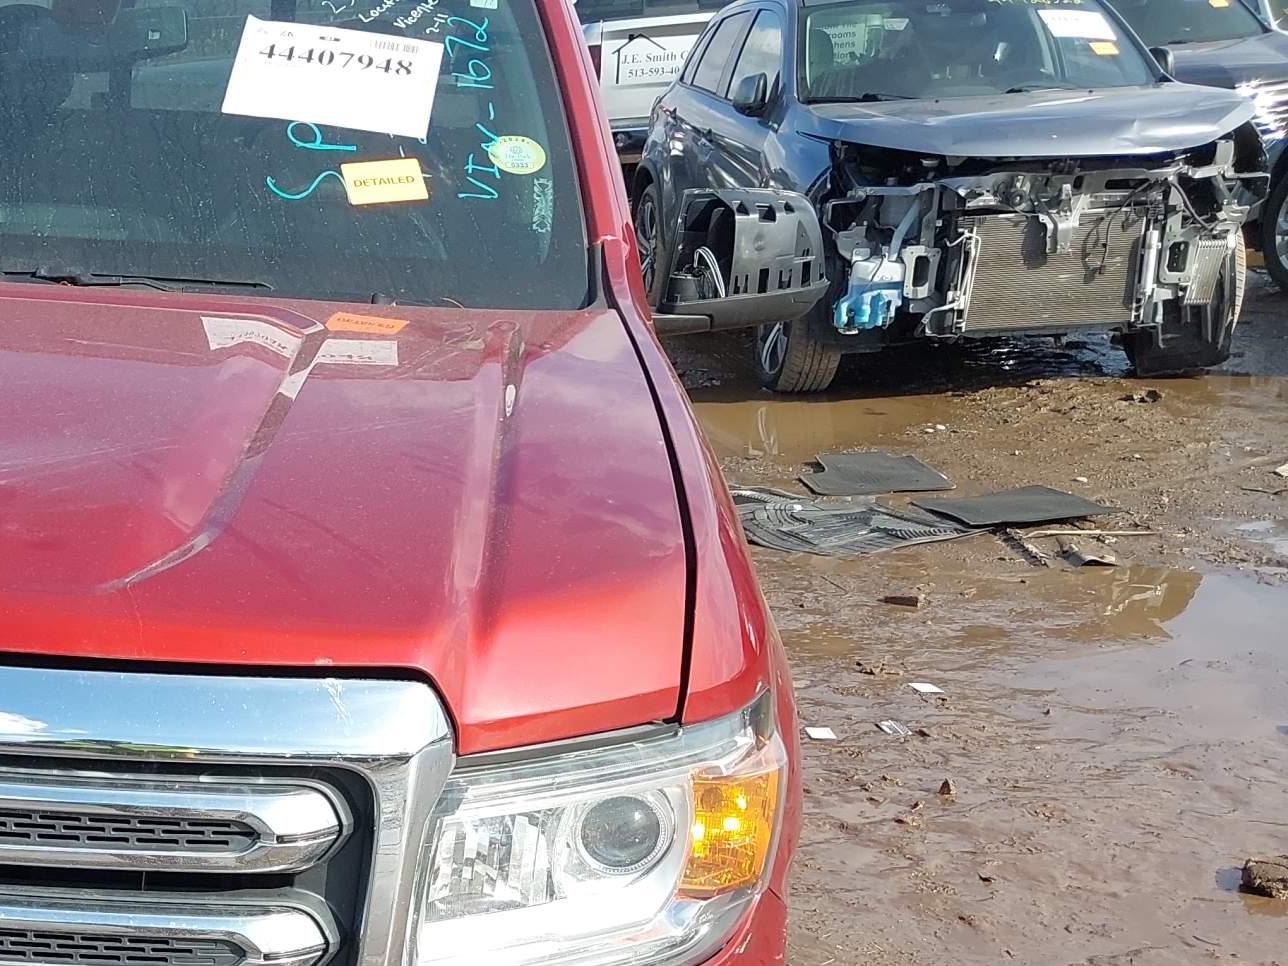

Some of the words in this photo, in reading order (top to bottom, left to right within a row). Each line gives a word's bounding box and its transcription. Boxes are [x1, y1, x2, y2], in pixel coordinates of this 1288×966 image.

[259, 43, 413, 76] 44407948
[645, 51, 677, 63] Smith
[628, 65, 680, 78] 513-593-40
[353, 175, 416, 188] DETAILED
